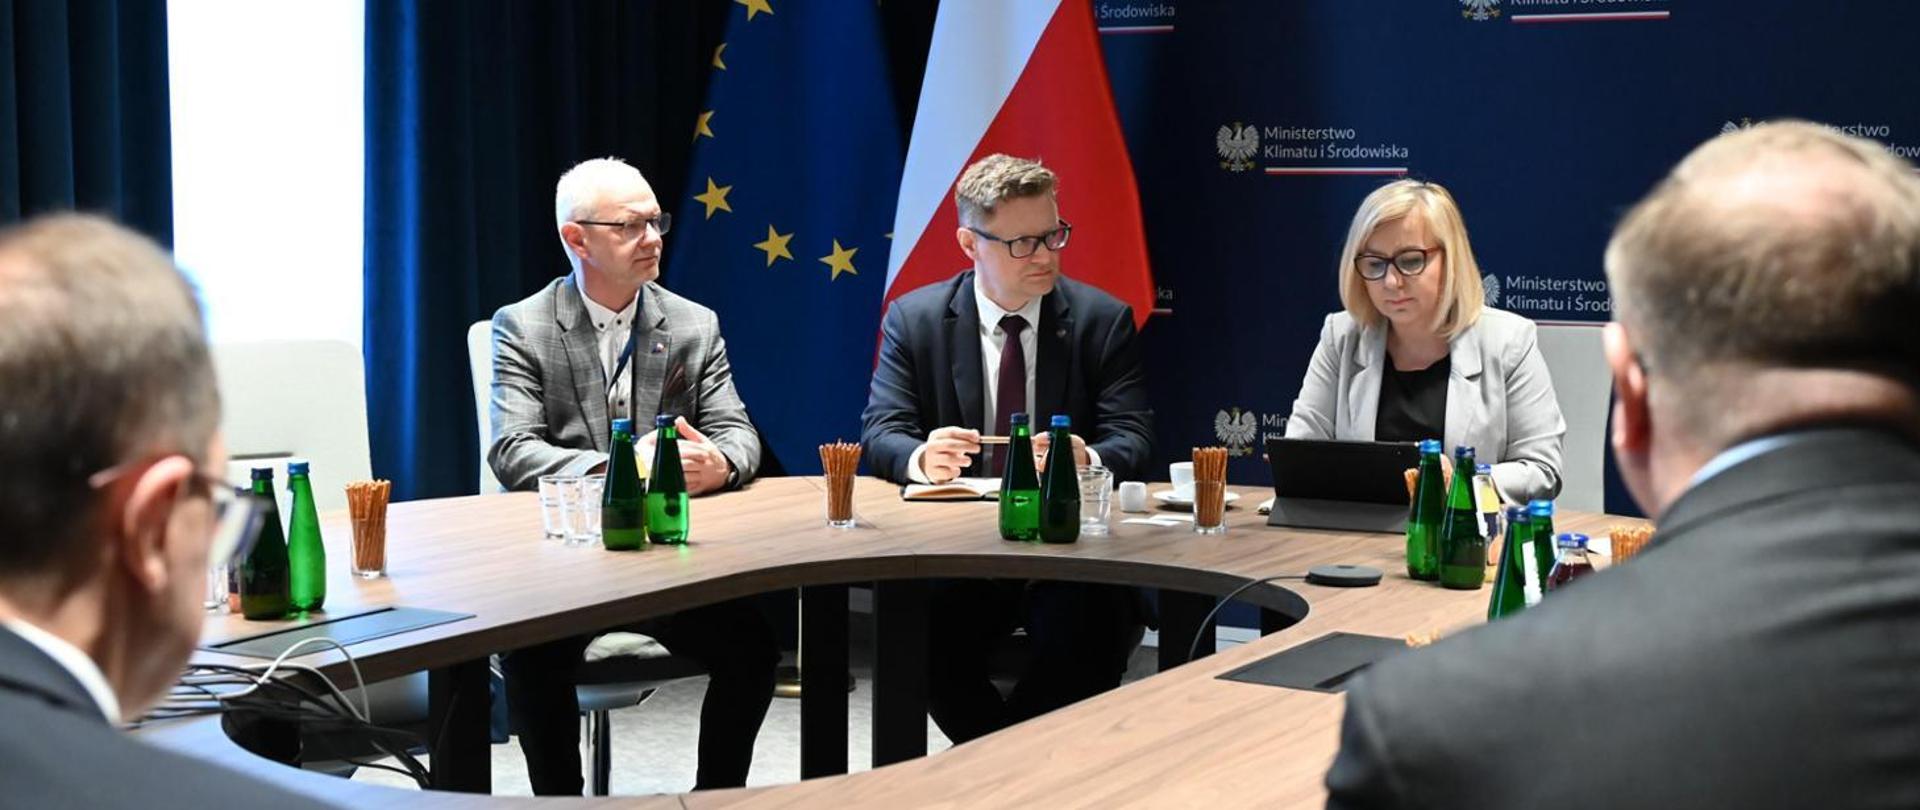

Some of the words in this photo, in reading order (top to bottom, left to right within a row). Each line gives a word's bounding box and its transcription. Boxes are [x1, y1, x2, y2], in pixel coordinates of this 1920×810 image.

[1101, 2, 1175, 18] Środowiska
[1264, 127, 1355, 140] Ministerstwo
[1264, 144, 1317, 158] Klimatu
[1320, 144, 1325, 158] i
[1327, 142, 1409, 158] Środowiska
[1506, 275, 1606, 292] Ministerstwo
[1506, 295, 1564, 310] Klimatu
[1567, 296, 1572, 311] i
